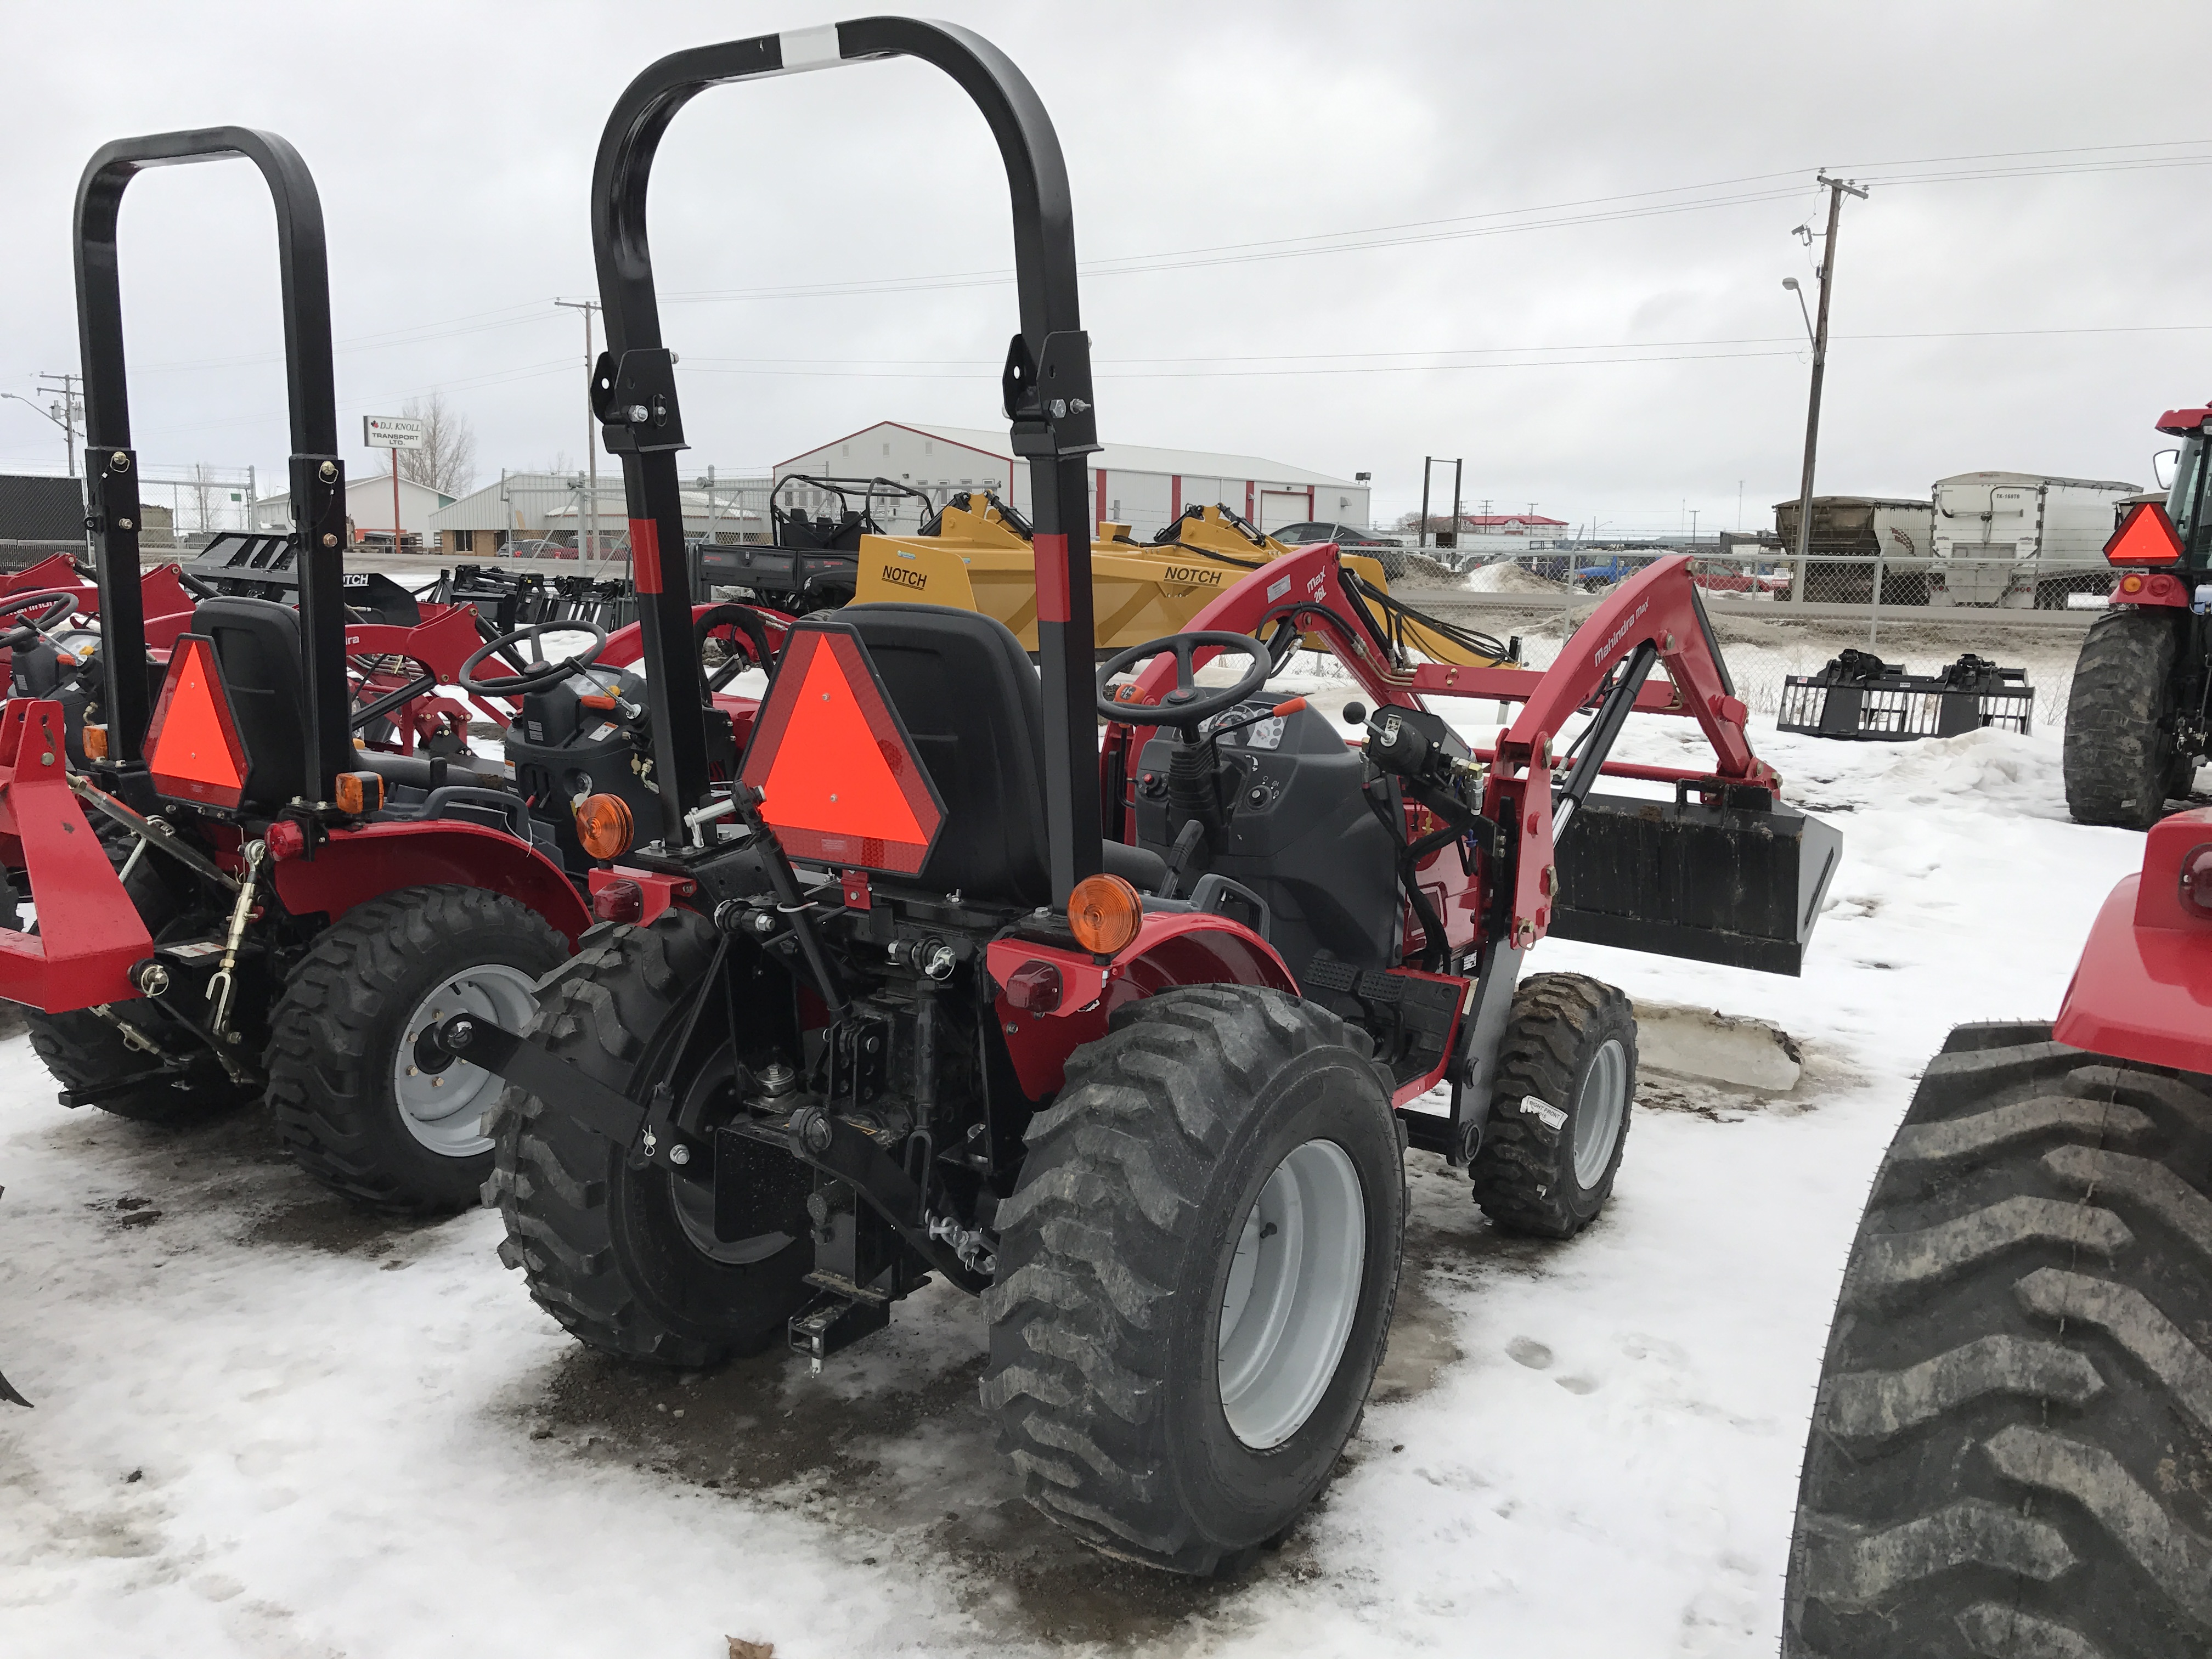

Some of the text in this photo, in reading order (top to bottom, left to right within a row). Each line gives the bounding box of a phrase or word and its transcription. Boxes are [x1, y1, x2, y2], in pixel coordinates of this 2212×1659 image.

[395, 422, 421, 432] KNOLL
[372, 432, 419, 441] TRANSPORT
[882, 565, 927, 588] NOTCH
[1164, 567, 1222, 584] NOTCH
[1314, 585, 1327, 603] 26L
[1544, 1108, 1560, 1119] FRONT
